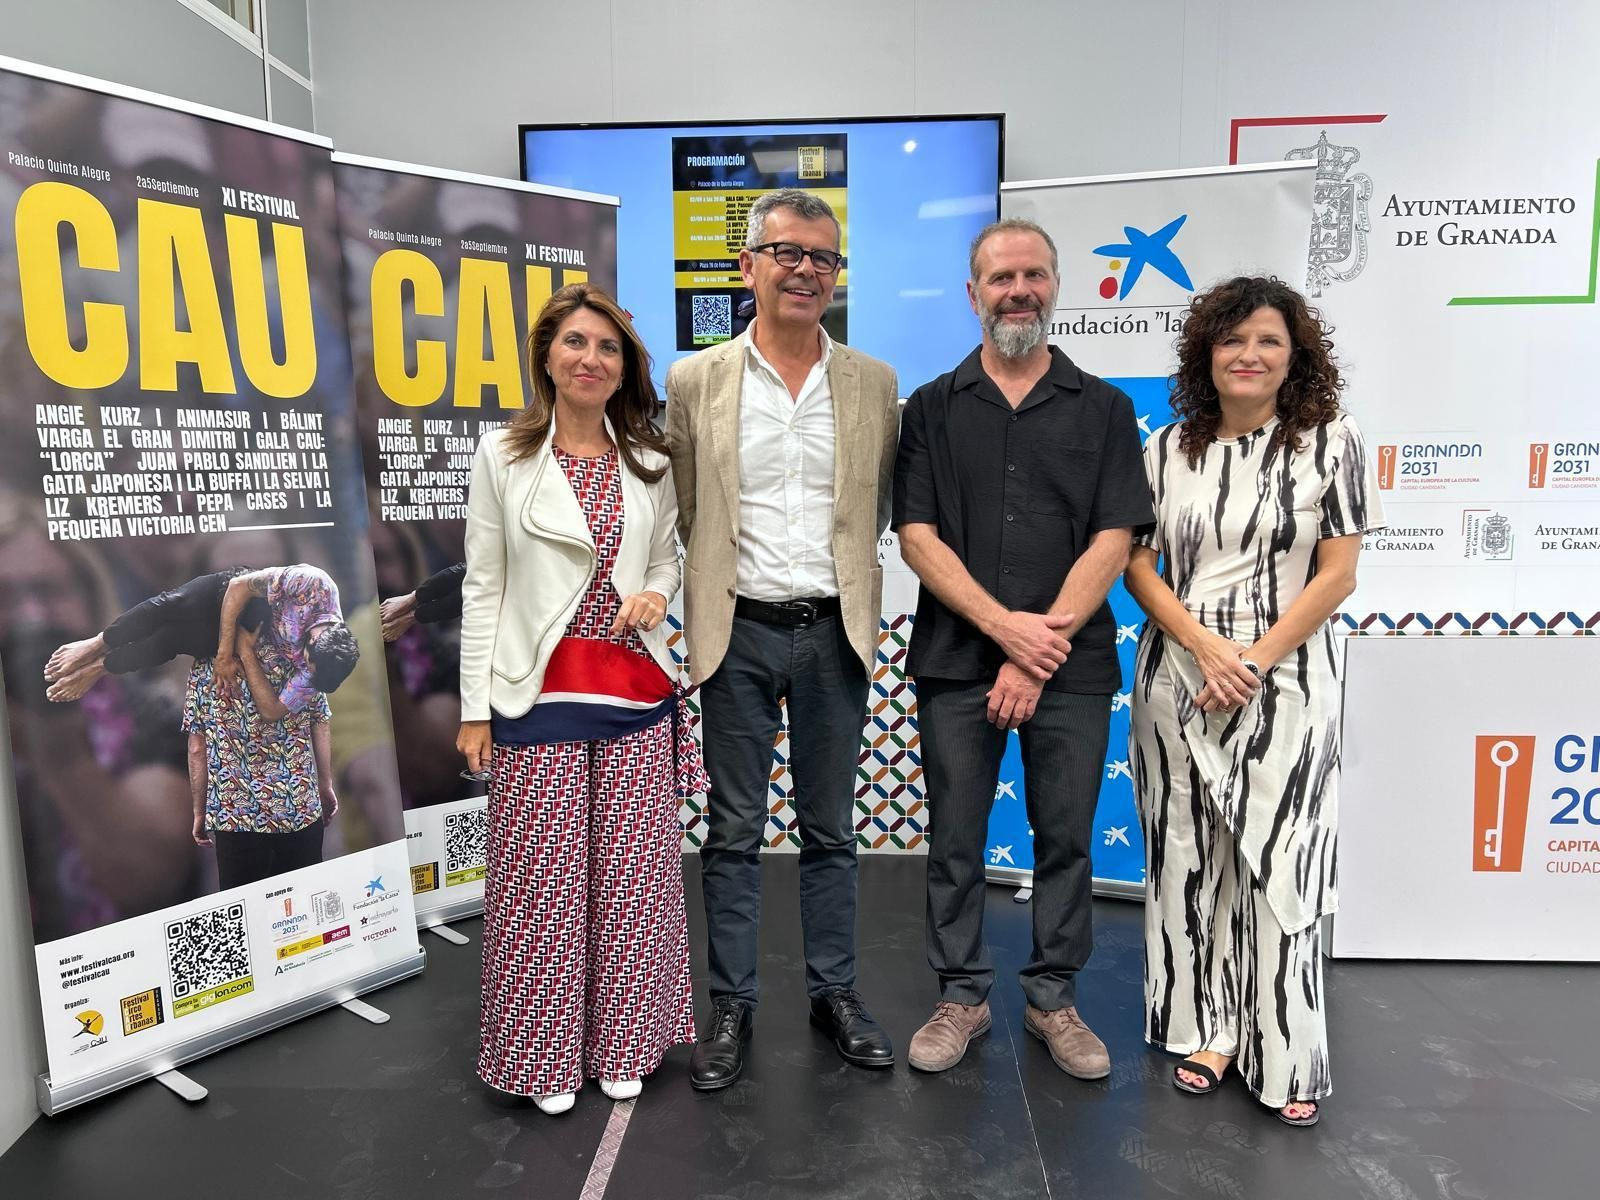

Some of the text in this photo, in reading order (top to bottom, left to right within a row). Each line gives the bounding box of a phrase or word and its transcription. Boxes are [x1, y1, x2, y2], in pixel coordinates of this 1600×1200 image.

[8, 151, 111, 182] Palacio Quinta Alegre
[687, 153, 745, 167] PROGRAMACIÓN
[136, 175, 200, 198] 2a5Septiembre
[221, 186, 300, 220] XI FESTIVAL
[1381, 193, 1576, 217] AYUNTAMIENTO
[368, 228, 442, 247] Palacio Quinta Alegre
[525, 243, 587, 266] XI FESTIVAL
[15, 181, 317, 398] CAU
[1048, 314, 1148, 335] undación
[35, 404, 85, 426] ANGIE
[100, 406, 142, 427] KURZ
[176, 409, 250, 430] ANIMASUR
[280, 409, 322, 431] BÁLINT
[378, 419, 413, 434] ANGIE
[423, 419, 453, 435] KURZ
[37, 427, 94, 449] VARGA
[103, 428, 123, 449] EL
[131, 429, 172, 449] GRAN
[181, 430, 237, 449] DIMITRI
[256, 431, 289, 449] GALA
[296, 432, 326, 450] CAU:
[378, 436, 475, 453] VARGA EL GRAN
[1402, 443, 1482, 458] GRANADA
[137, 452, 177, 471] JUAN
[184, 452, 230, 471] PABLO
[235, 452, 298, 470] SANDLIEN
[312, 453, 328, 469] LA
[1401, 461, 1438, 476] 2031
[1552, 460, 1589, 474] 2031
[42, 475, 87, 496] GATA
[91, 473, 173, 494] JAPONESA
[187, 473, 205, 492] LA
[209, 473, 251, 491] BUFFA
[263, 472, 280, 490] LA
[283, 471, 322, 490] SELVA
[380, 471, 471, 487] GATA JAPONESA
[45, 497, 70, 518] LIZ
[86, 495, 163, 517] KREMERS
[197, 493, 234, 513] PEPA
[246, 492, 288, 511] CASES
[316, 490, 332, 509] LA
[380, 488, 464, 504] LIZ KREMERS
[381, 503, 468, 522] PEQUEÑA VICTO
[47, 513, 124, 541] PEQUEÑA
[126, 515, 196, 538] VICTORIA
[1367, 528, 1444, 537] UNTAMIENTO
[274, 889, 286, 897] apoyo
[272, 914, 308, 930] GRANADA
[282, 925, 299, 935] 2031
[362, 926, 397, 942] VICTORIA
[59, 957, 71, 966] Más
[60, 950, 135, 979] www.festivalcau.org
[62, 968, 110, 989] @festivalcau
[64, 997, 90, 1010] Organiza:
[123, 993, 149, 1009] Festival
